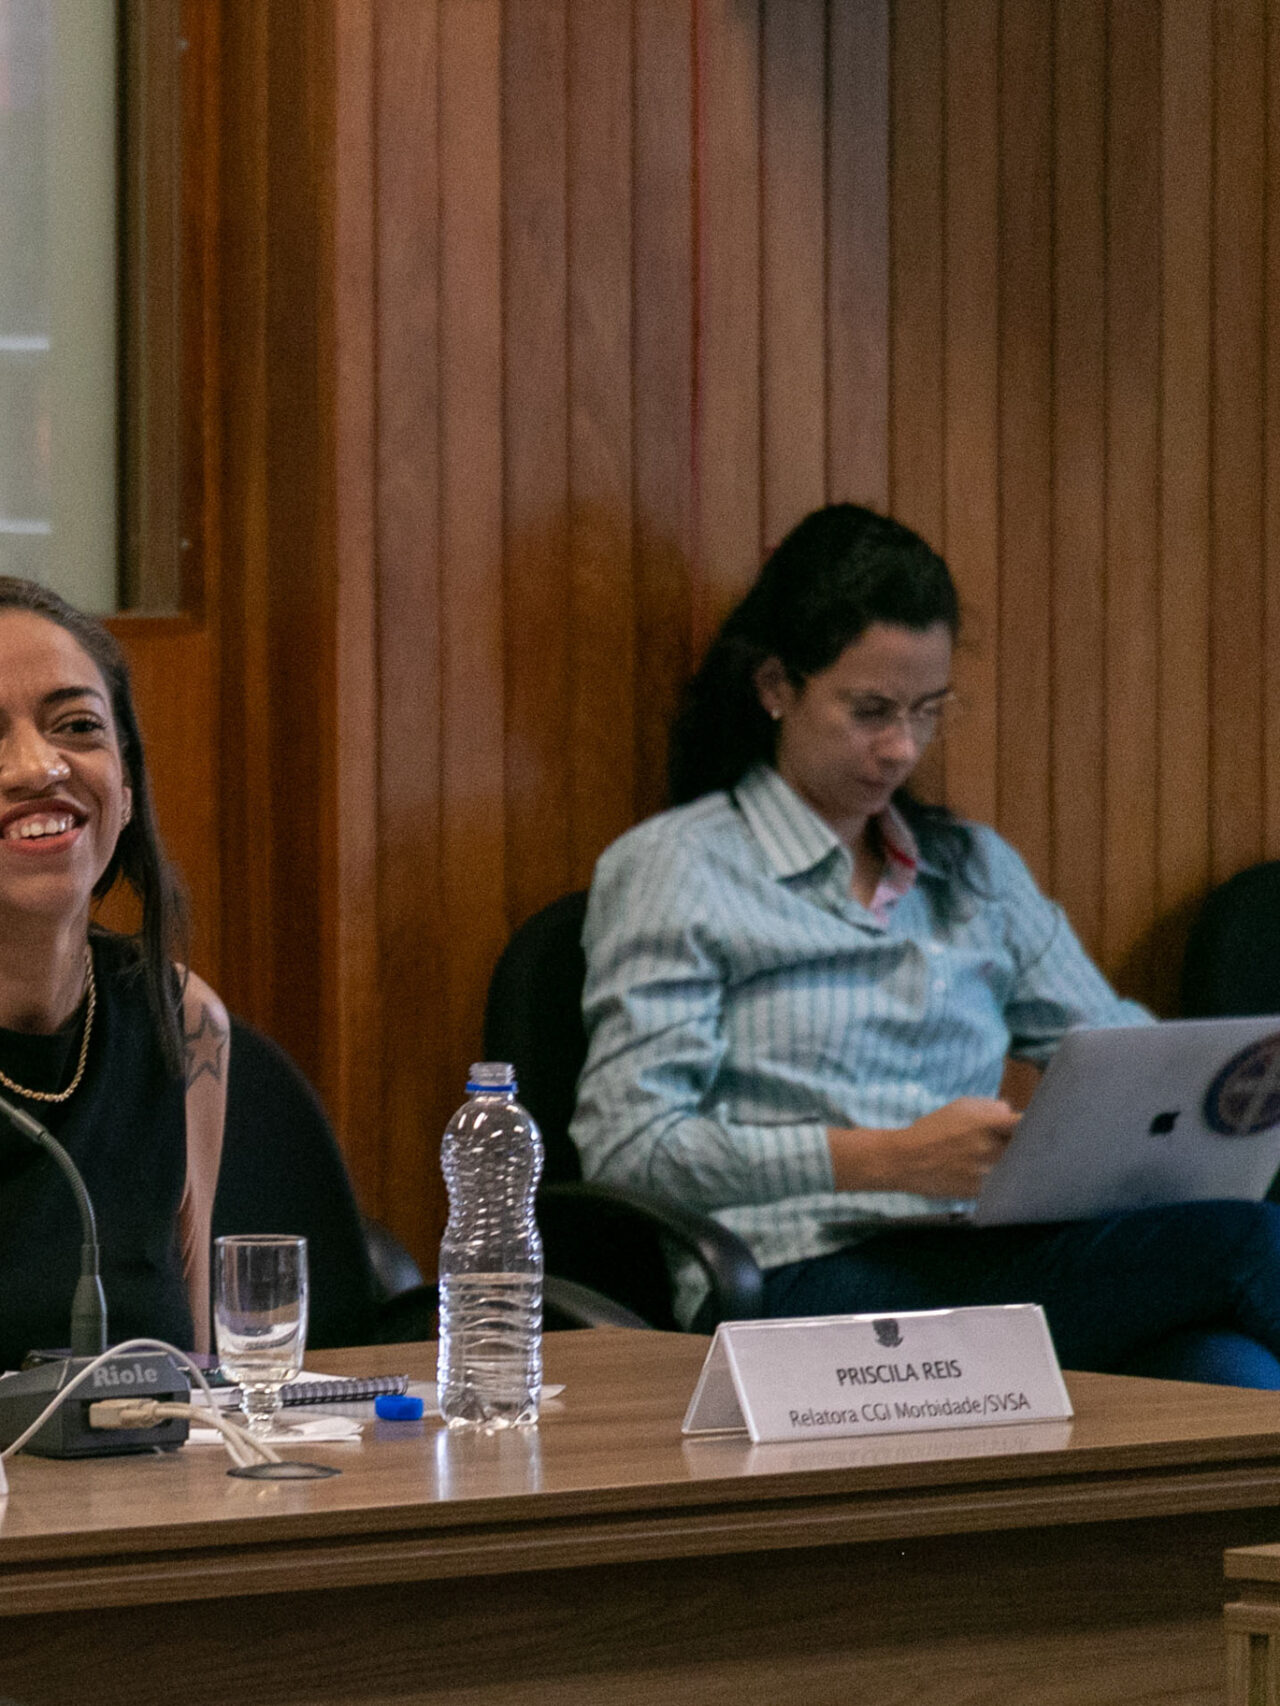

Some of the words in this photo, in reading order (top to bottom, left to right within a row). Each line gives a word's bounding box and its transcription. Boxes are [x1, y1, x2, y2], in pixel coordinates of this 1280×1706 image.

[93, 1363, 157, 1388] Riole
[836, 1363, 920, 1387] PRISCILA
[922, 1359, 962, 1380] REIS
[789, 1406, 859, 1428] Relatora
[861, 1403, 892, 1423] CGI
[895, 1392, 1031, 1420] Morbidade/SVSA
